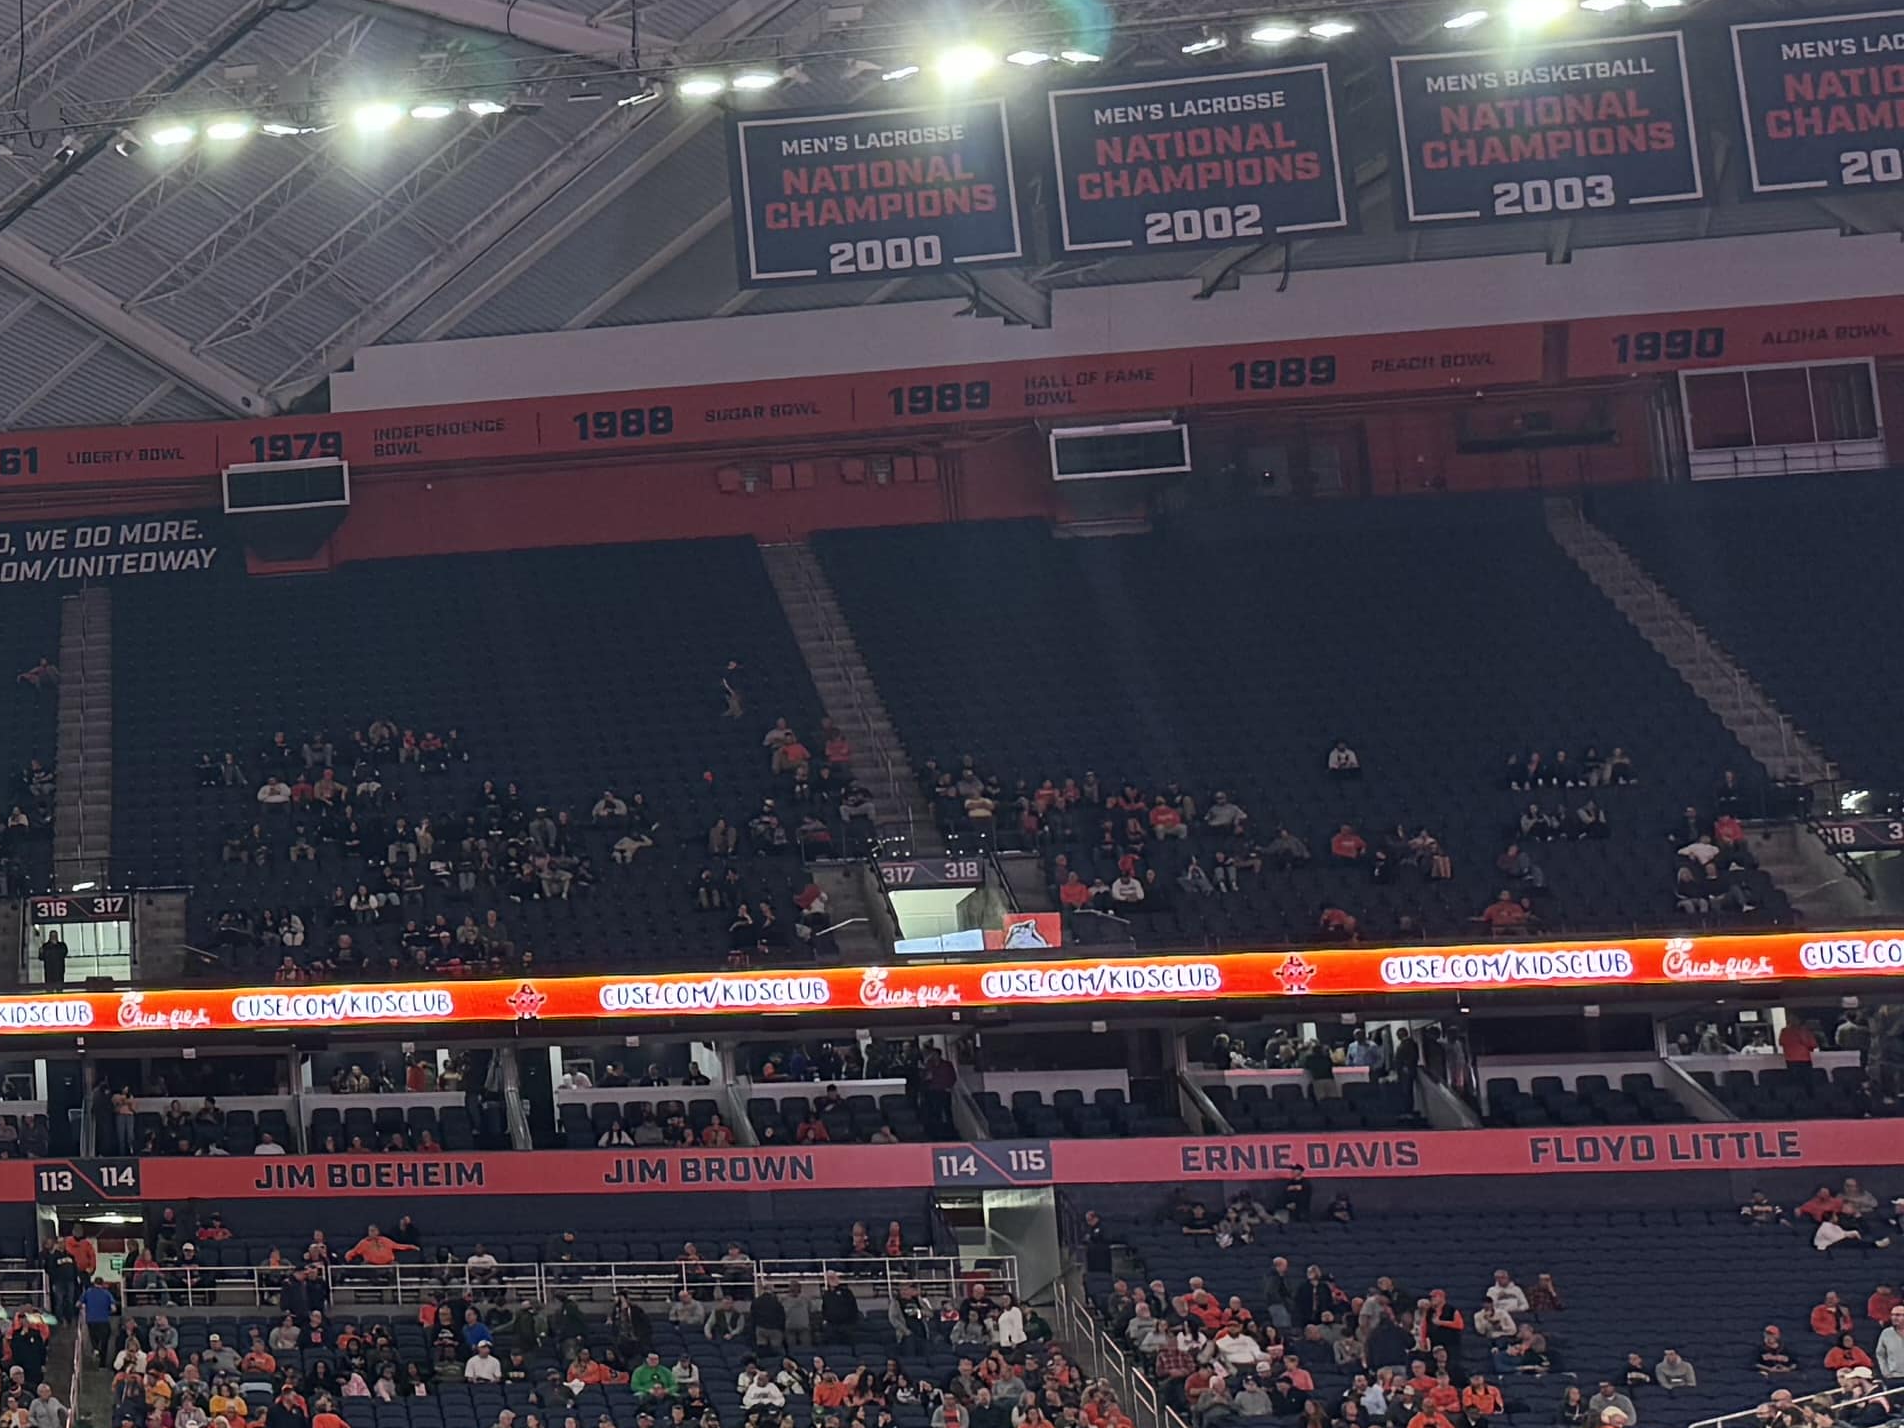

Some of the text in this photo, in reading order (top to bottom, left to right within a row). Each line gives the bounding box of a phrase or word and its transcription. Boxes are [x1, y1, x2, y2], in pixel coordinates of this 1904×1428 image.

[1781, 38, 1856, 60] MEN'S
[1426, 58, 1655, 94] MEN'S BASKETBALL
[1094, 91, 1285, 125] MEN'S LACROSSE
[1440, 89, 1650, 136] NATIONAL
[781, 124, 964, 156] MEN'S LACROSSE
[1095, 121, 1296, 166] NATIONAL
[1422, 122, 1675, 171] CHAMPIONS
[782, 152, 975, 195] NATIONAL
[1077, 151, 1321, 202] CHAMPIONS
[765, 184, 997, 230] CHAMPIONS
[1493, 175, 1615, 217] 2003
[1145, 204, 1262, 245] 2002
[829, 235, 941, 274] 2000
[1611, 324, 1891, 363] 1990 ALOHA BOWL
[1228, 356, 1337, 391] 1989
[1371, 352, 1497, 374] PEACH BOWL
[887, 381, 991, 415] 1989
[572, 401, 821, 441] 1988 SUGAR BOWL
[66, 449, 133, 466] LIBERTY
[139, 446, 185, 463] BOWL
[249, 417, 505, 463] 1979 INDEPENDENCE
[26, 529, 68, 552] WE
[75, 526, 109, 548] DO
[119, 520, 204, 544] MORE.
[883, 868, 914, 883] 317
[945, 862, 978, 878] 318
[37, 901, 67, 918] 316
[93, 897, 122, 914] 317
[1008, 1149, 1045, 1172] 115
[1182, 1138, 1419, 1173] ERNIE DAVIS
[1530, 1129, 1802, 1166] FLOYD LITTLE
[40, 1172, 72, 1192] 113
[100, 1167, 136, 1188] 114
[255, 1160, 484, 1190] JIM BOEHEIM
[604, 1155, 815, 1185] JIM BROWN
[939, 1155, 977, 1178] 114
